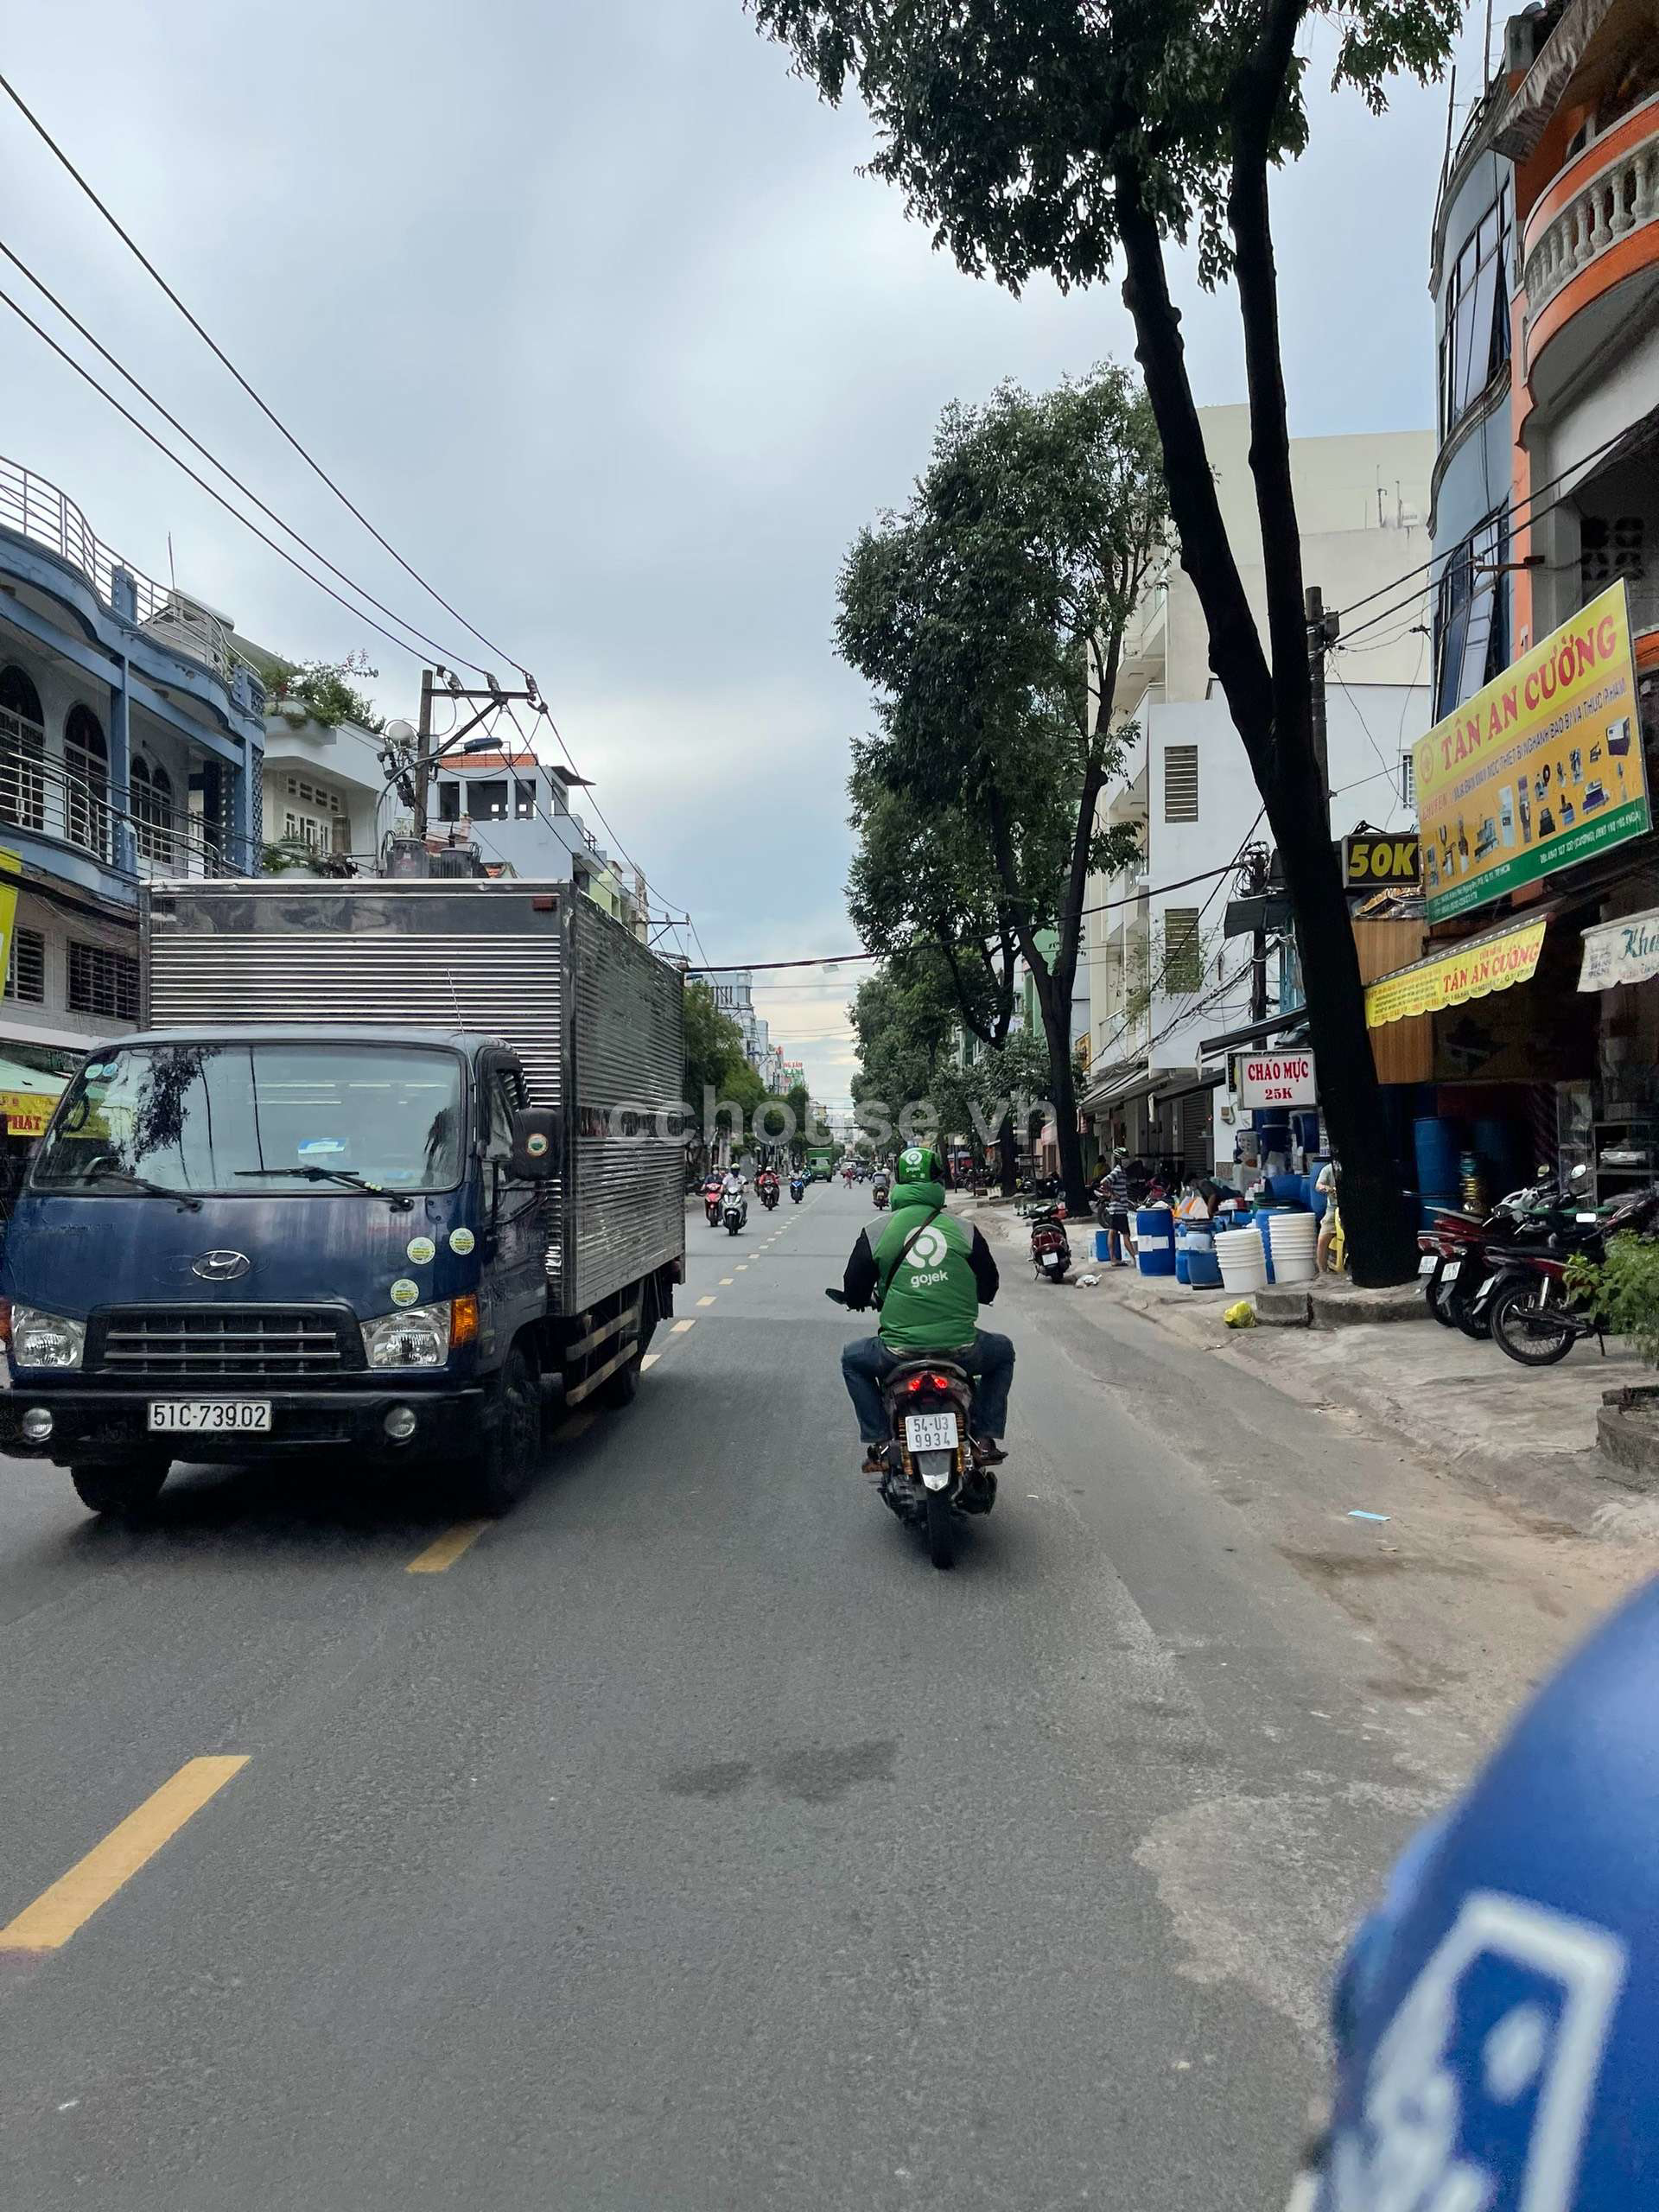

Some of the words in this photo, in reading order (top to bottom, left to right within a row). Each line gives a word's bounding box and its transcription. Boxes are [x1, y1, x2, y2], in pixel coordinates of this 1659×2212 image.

[1440, 714, 1481, 772] TÂN
[1487, 684, 1519, 741] AN
[1523, 614, 1618, 711] CƯỜNG
[1348, 842, 1419, 877] 50K
[1471, 960, 1490, 984] AN
[1248, 1058, 1281, 1081] CHÁO
[1283, 1057, 1309, 1083] MỰC
[1265, 1088, 1293, 1100] 25K
[911, 1270, 949, 1288] gojek
[154, 1404, 266, 1427] 51C-739.02
[916, 1432, 950, 1448] 9934
